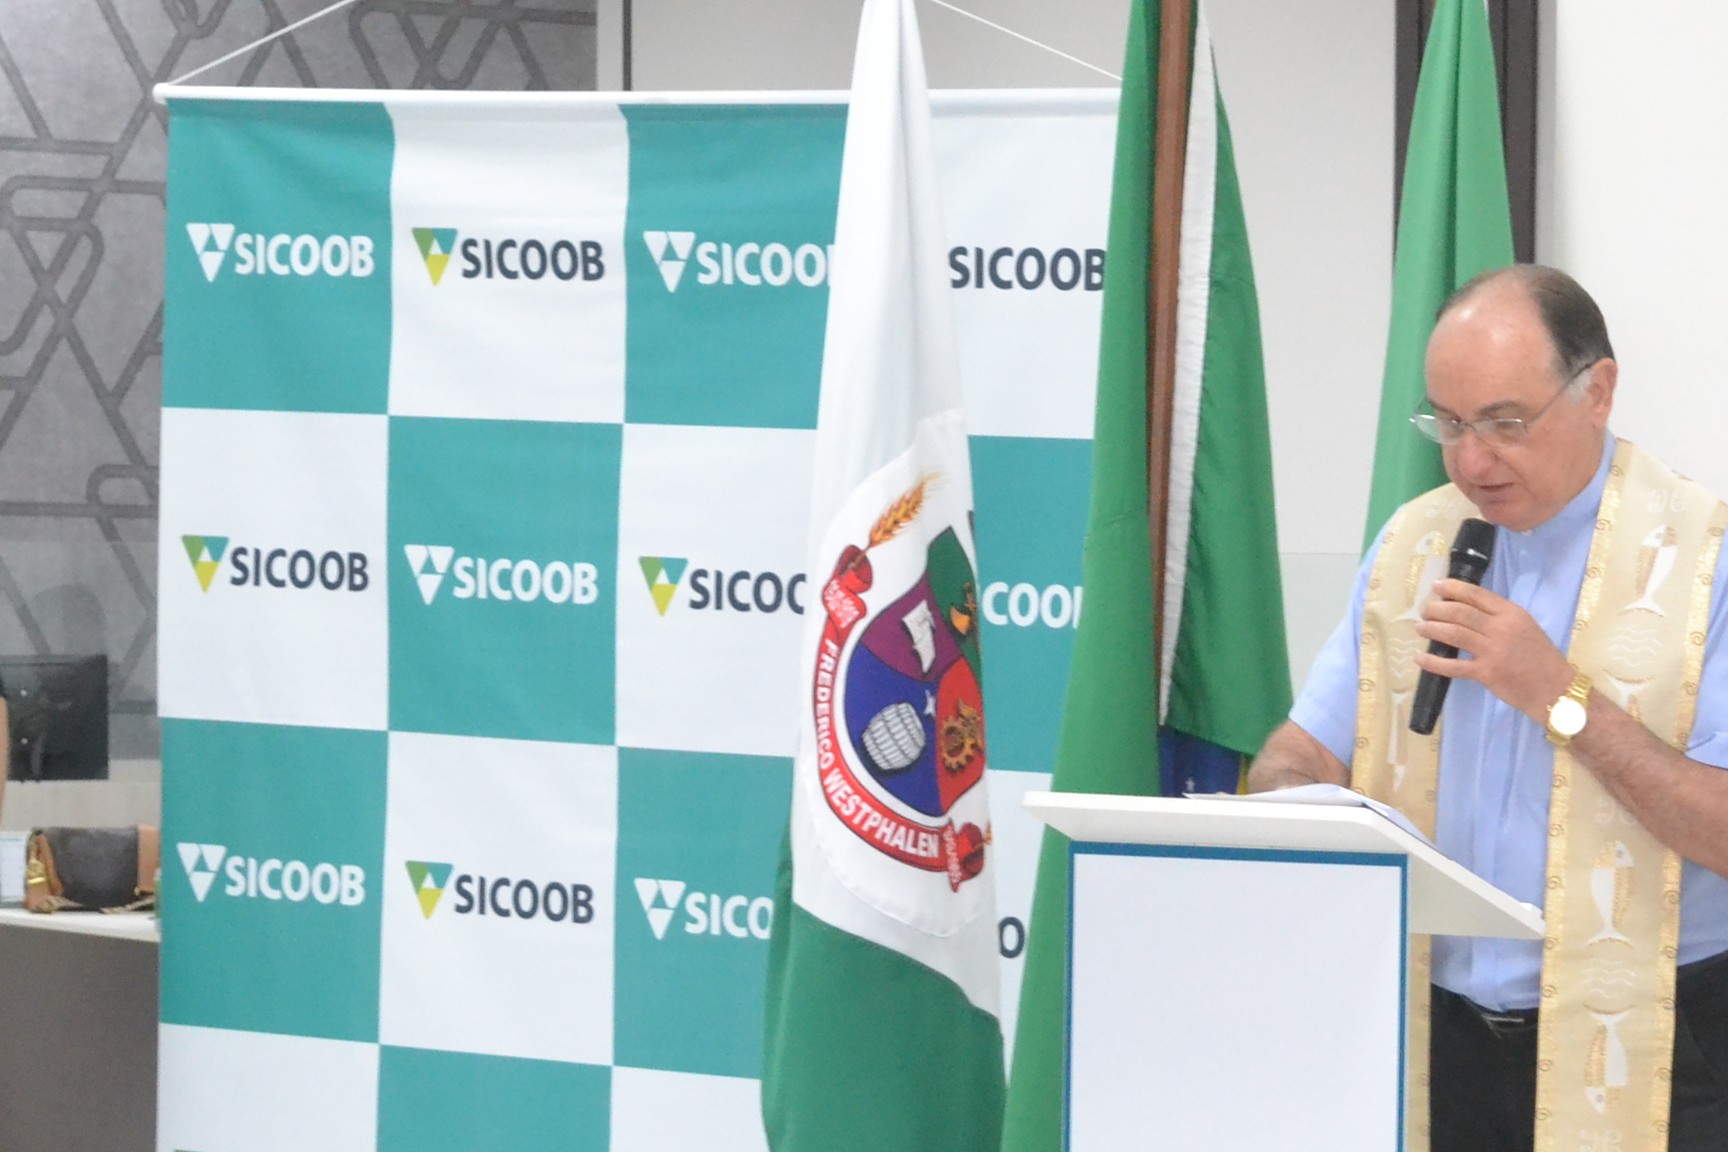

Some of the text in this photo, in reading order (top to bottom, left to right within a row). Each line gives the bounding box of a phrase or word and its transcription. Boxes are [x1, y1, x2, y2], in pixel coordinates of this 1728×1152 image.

[234, 232, 375, 279] SICOOB
[461, 238, 606, 282] SICOOB
[696, 241, 833, 288] SICOO
[948, 246, 1106, 292] SICOOB
[229, 546, 370, 592] SICOOB
[452, 557, 599, 605] SICOOB
[816, 637, 940, 859] FREDERICO WESTPHALEN
[225, 855, 366, 907] SICOOB
[455, 874, 595, 924] SICOOB
[684, 891, 774, 940] SICO
